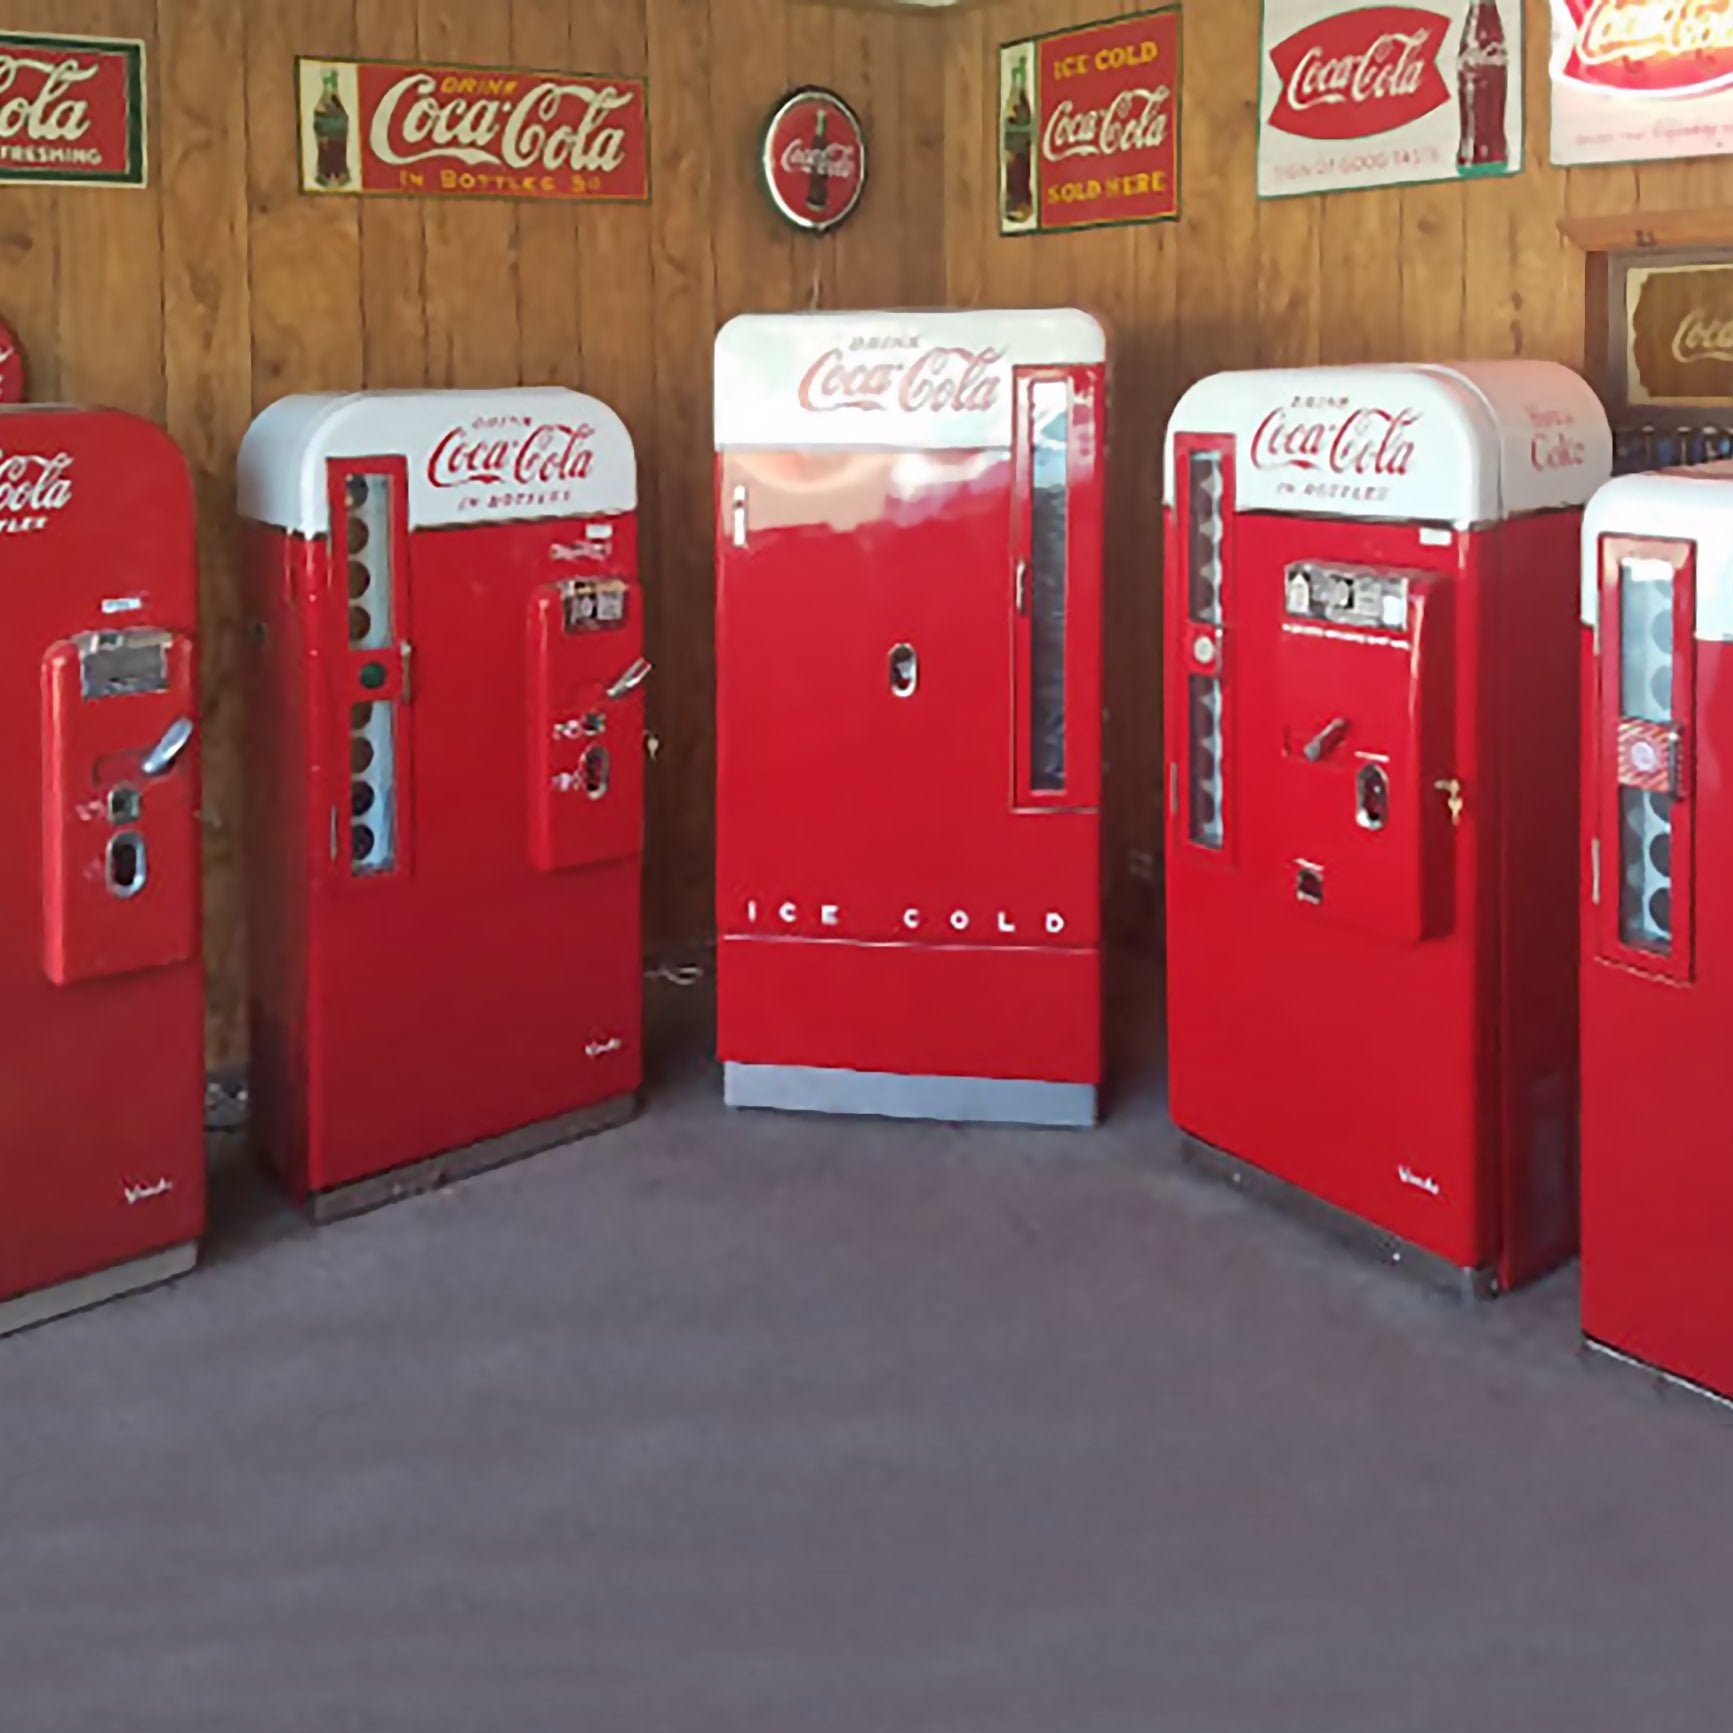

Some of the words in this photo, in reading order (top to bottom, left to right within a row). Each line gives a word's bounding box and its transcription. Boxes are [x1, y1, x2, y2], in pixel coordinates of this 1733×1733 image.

[1054, 54, 1088, 80] ICE
[1095, 41, 1158, 71] COLD
[440, 77, 517, 94] DRINK
[1048, 180, 1101, 204] SOLD
[748, 900, 839, 926] ICE
[903, 908, 1065, 934] COLD
